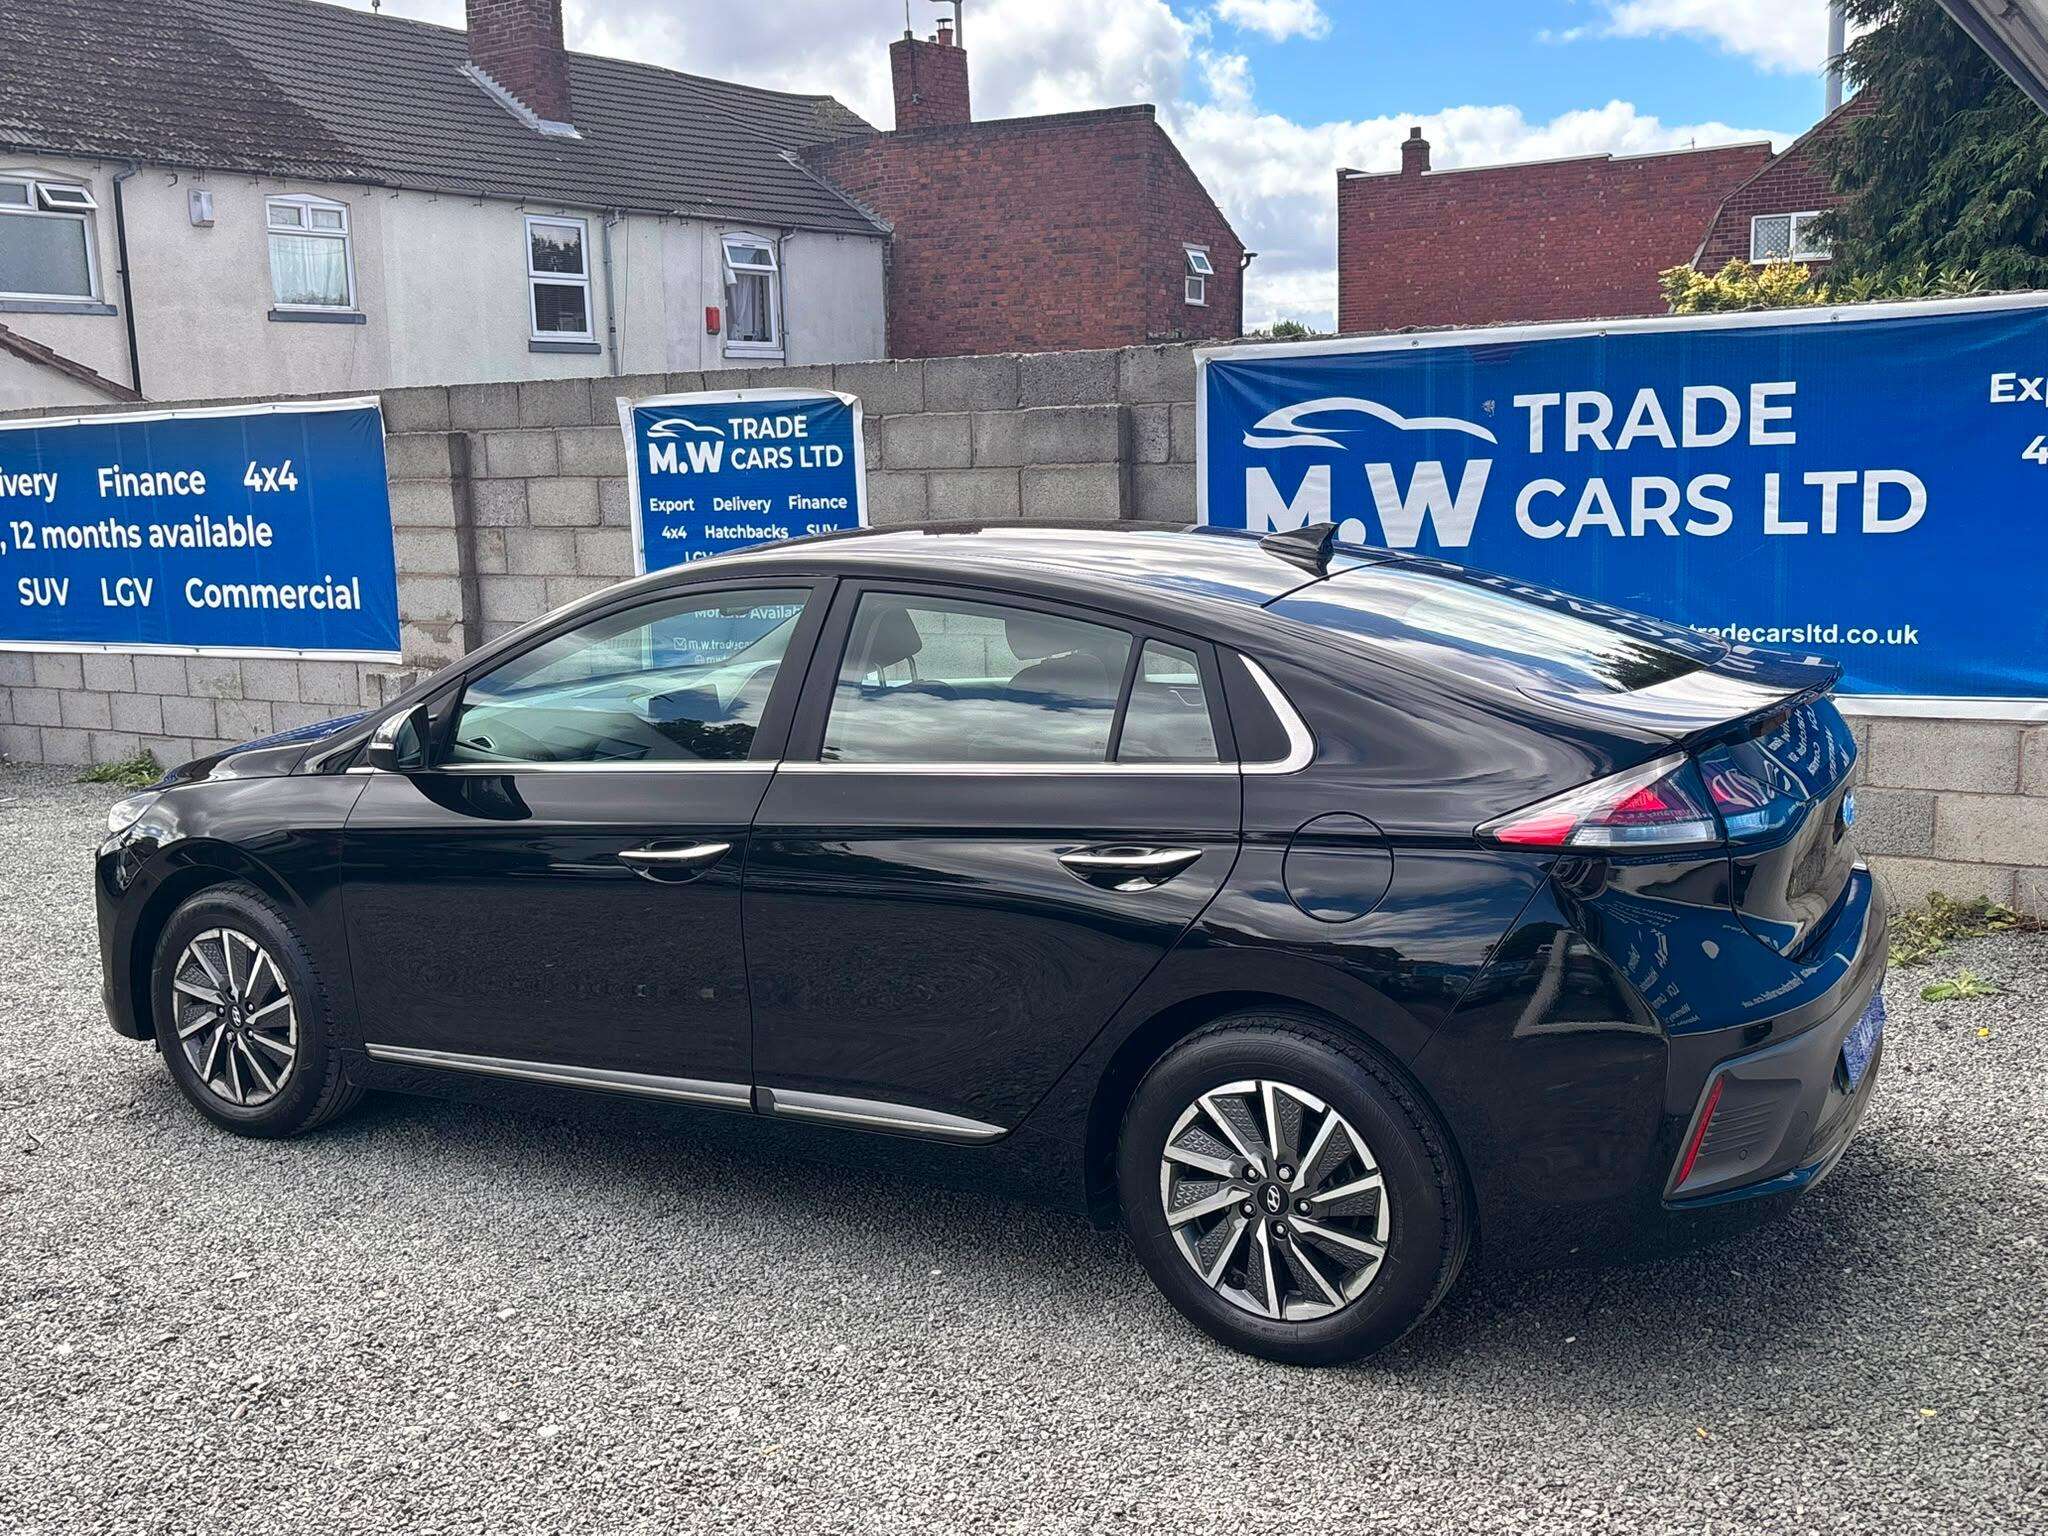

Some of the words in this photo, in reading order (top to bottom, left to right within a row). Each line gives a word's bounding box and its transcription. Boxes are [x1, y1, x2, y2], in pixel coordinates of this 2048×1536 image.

[1990, 373, 2048, 408] Ex
[728, 416, 808, 440] TRADE
[1513, 381, 1797, 453] TRADE
[648, 441, 725, 474] M.W
[731, 446, 793, 470] CARS
[800, 445, 843, 468] LTD
[98, 464, 206, 497] Finance
[243, 459, 298, 492] 4x4
[650, 498, 695, 514] Export
[714, 496, 771, 514] Delivery
[789, 494, 848, 510] Finance
[1246, 459, 1493, 548] M.W
[1515, 473, 1734, 540] CARS
[1763, 469, 1928, 535] LTD
[10, 521, 36, 549] 12
[42, 518, 142, 549] months
[149, 514, 273, 548] available
[662, 525, 687, 539] 4x4
[705, 524, 789, 539] Hatchbacks
[18, 577, 69, 606] SUV
[101, 577, 153, 607] LGV
[185, 575, 361, 609] Commercial
[750, 605, 804, 619] Availab
